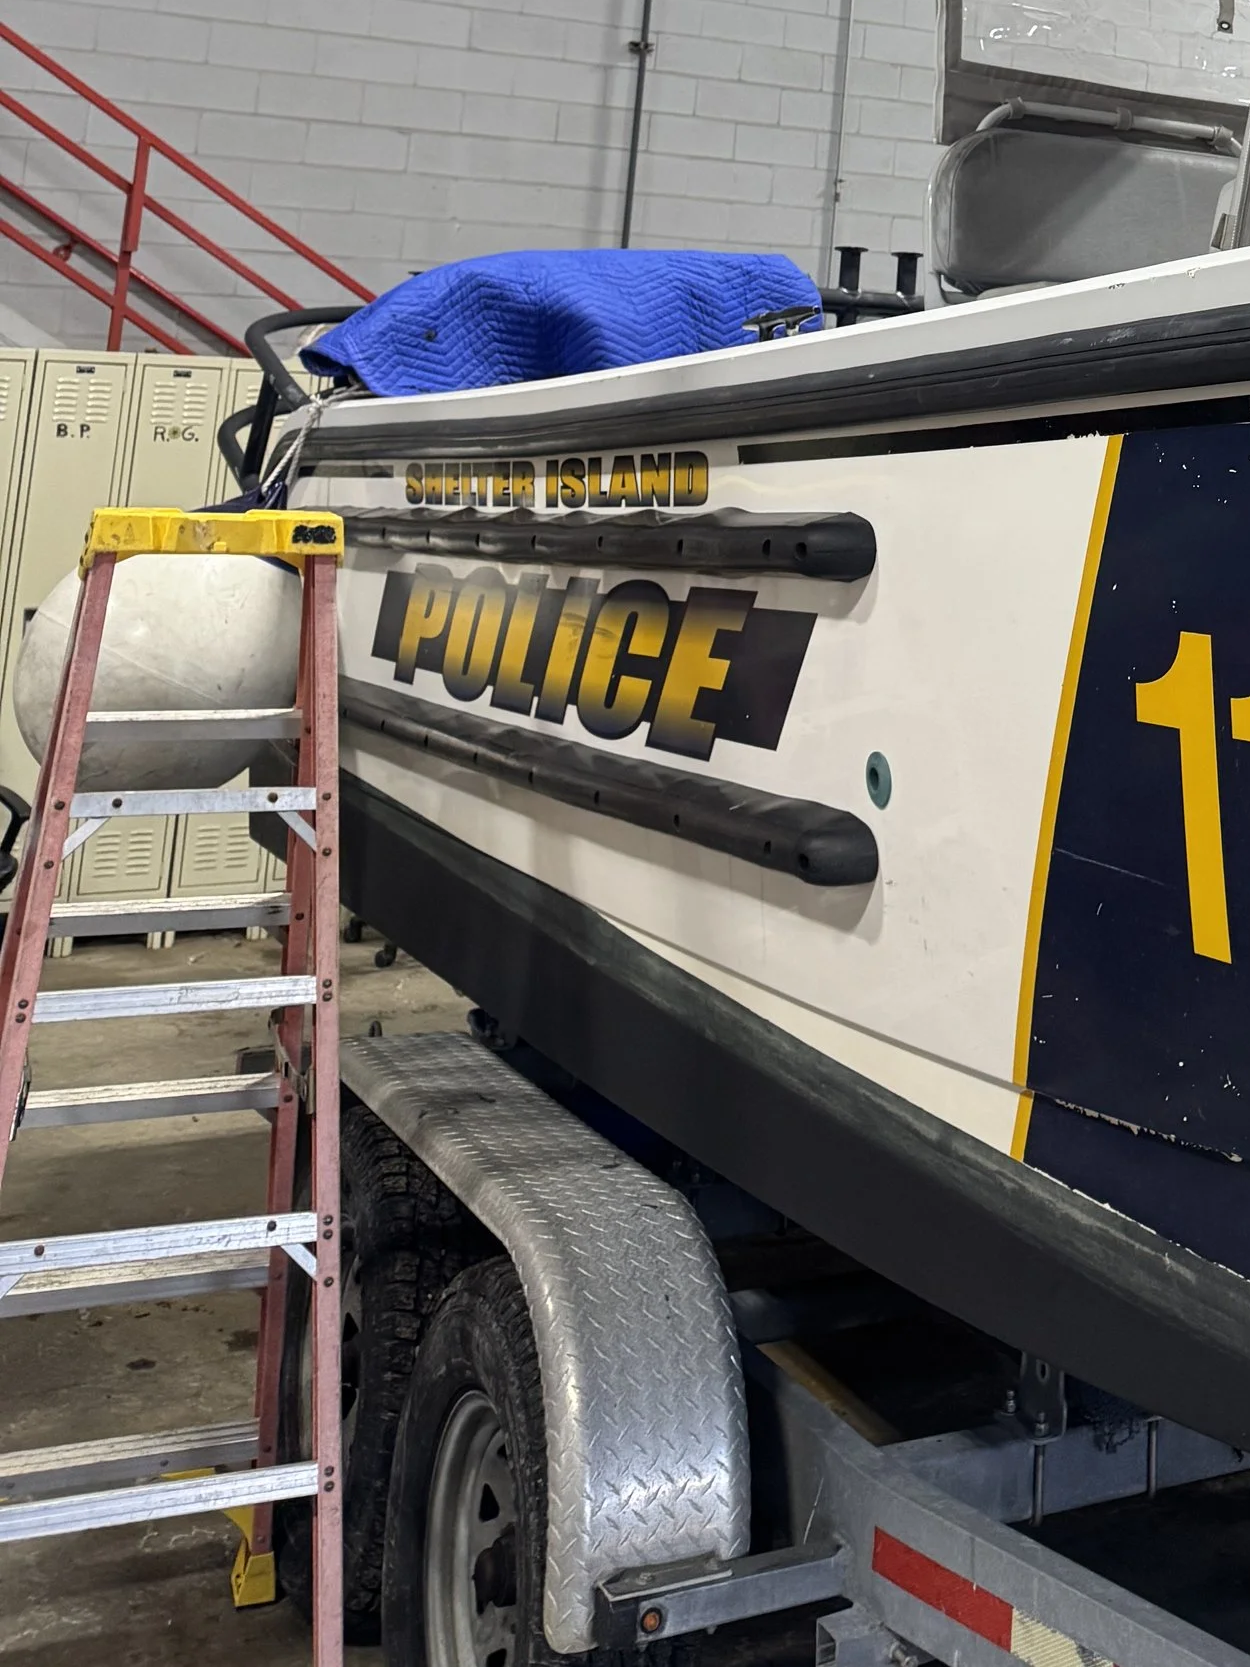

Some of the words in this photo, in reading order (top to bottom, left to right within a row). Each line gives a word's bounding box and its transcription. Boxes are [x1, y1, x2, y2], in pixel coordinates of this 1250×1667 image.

[405, 461, 535, 508] SHELTER
[546, 451, 709, 508] ISLAND
[394, 563, 758, 762] POLICE
